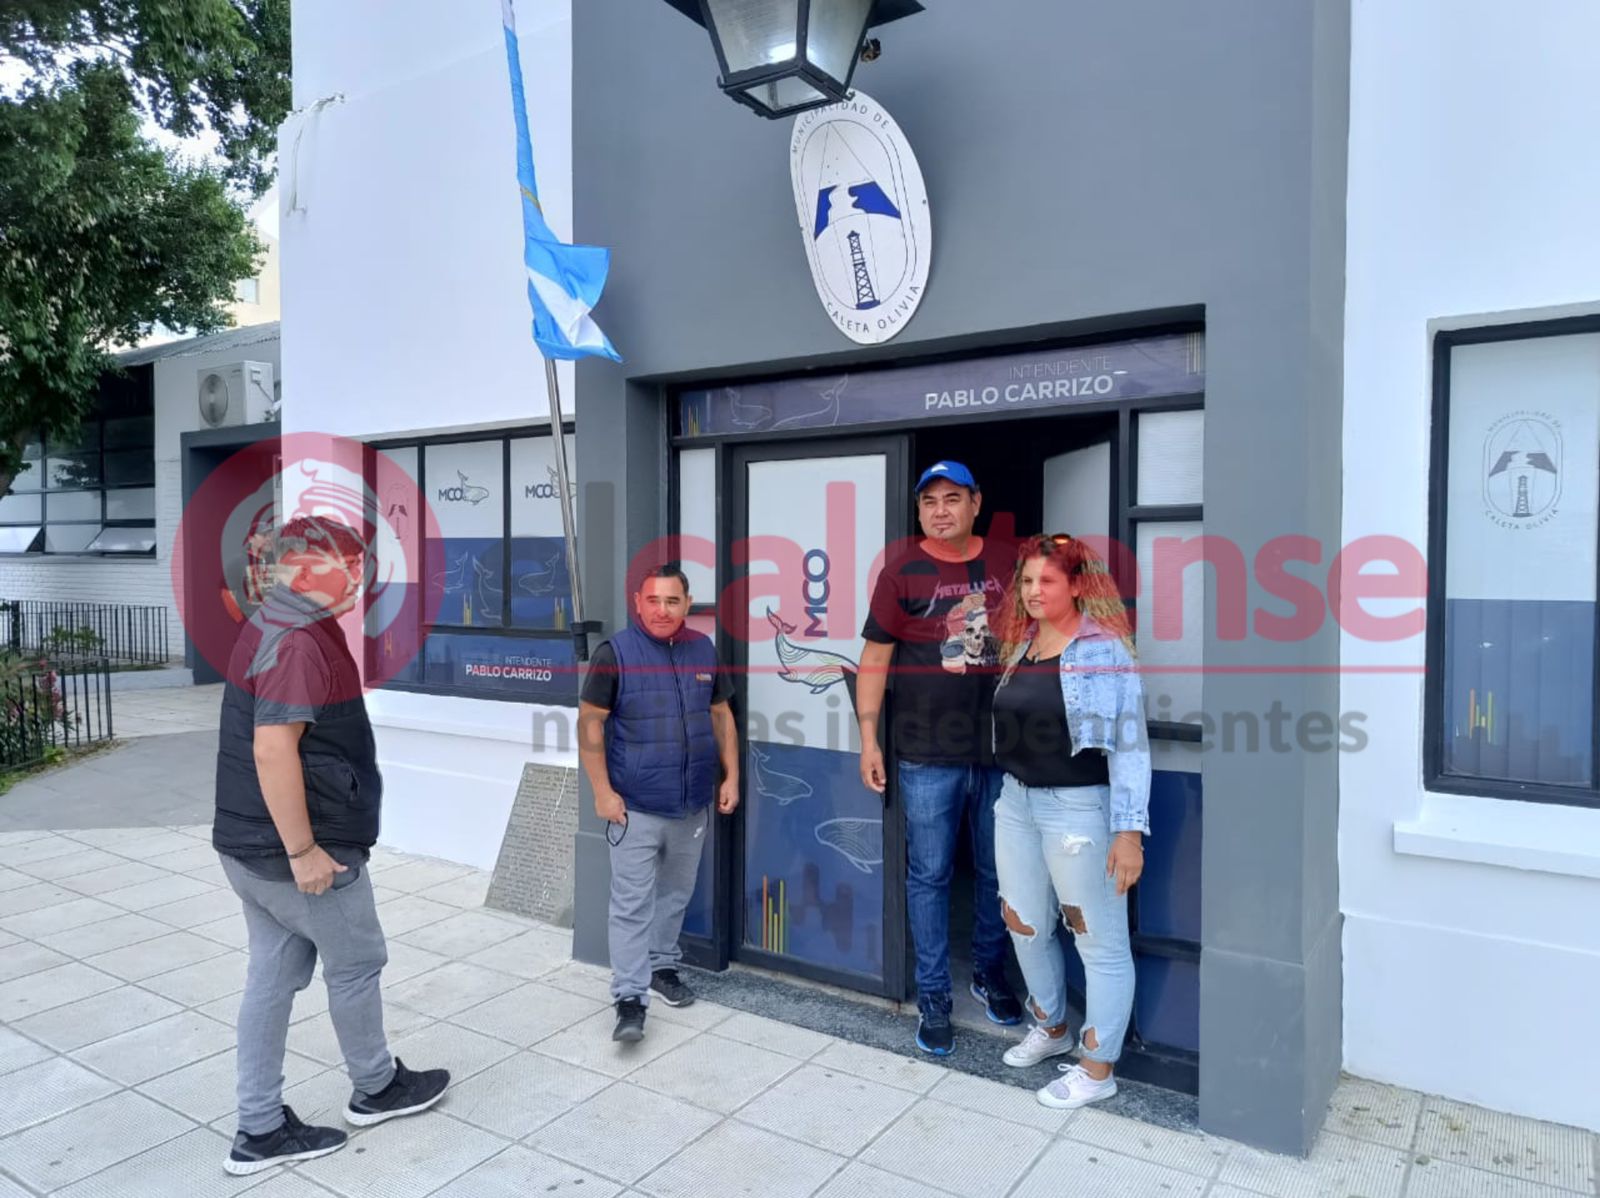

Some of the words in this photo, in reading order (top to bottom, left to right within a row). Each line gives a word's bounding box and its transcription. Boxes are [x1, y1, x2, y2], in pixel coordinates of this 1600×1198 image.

[873, 112, 890, 130] DE
[826, 301, 871, 334] CALETA
[877, 284, 921, 331] OLIVIA
[1008, 355, 1113, 380] INTENDENTE
[924, 386, 999, 411] PABLO
[1004, 374, 1114, 403] CARRIZO
[438, 487, 463, 502] MCO
[525, 483, 553, 499] MCO
[802, 548, 831, 638] MCO
[504, 655, 552, 668] INTENDENTE
[465, 663, 501, 678] PABLO
[502, 666, 552, 682] CARRIZO
